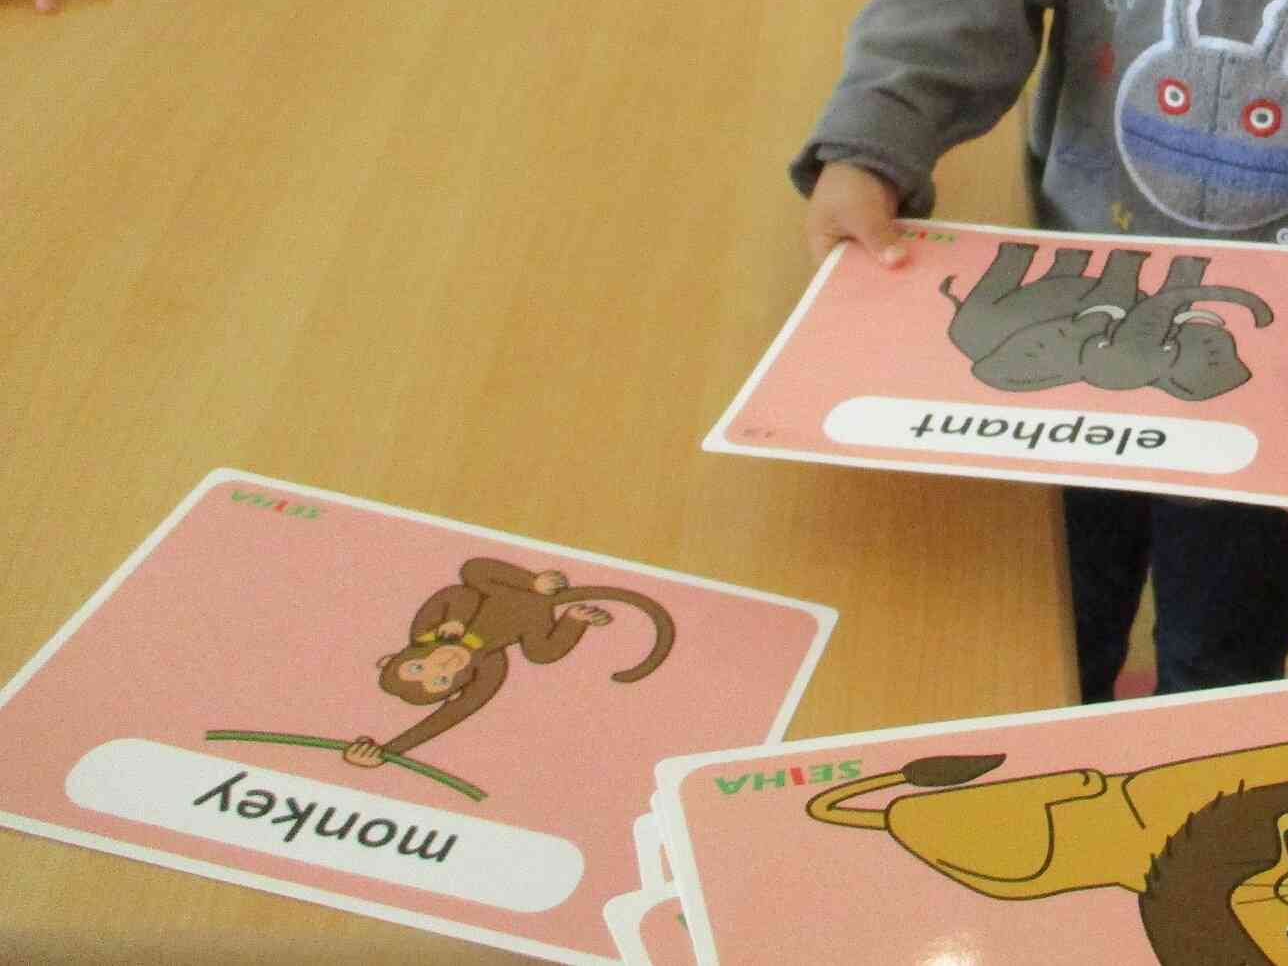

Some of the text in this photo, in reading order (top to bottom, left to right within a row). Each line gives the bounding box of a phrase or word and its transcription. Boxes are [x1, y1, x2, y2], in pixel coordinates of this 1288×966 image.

[909, 413, 1168, 456] elephant
[714, 759, 863, 795] SEIHA
[193, 770, 459, 863] monkey
